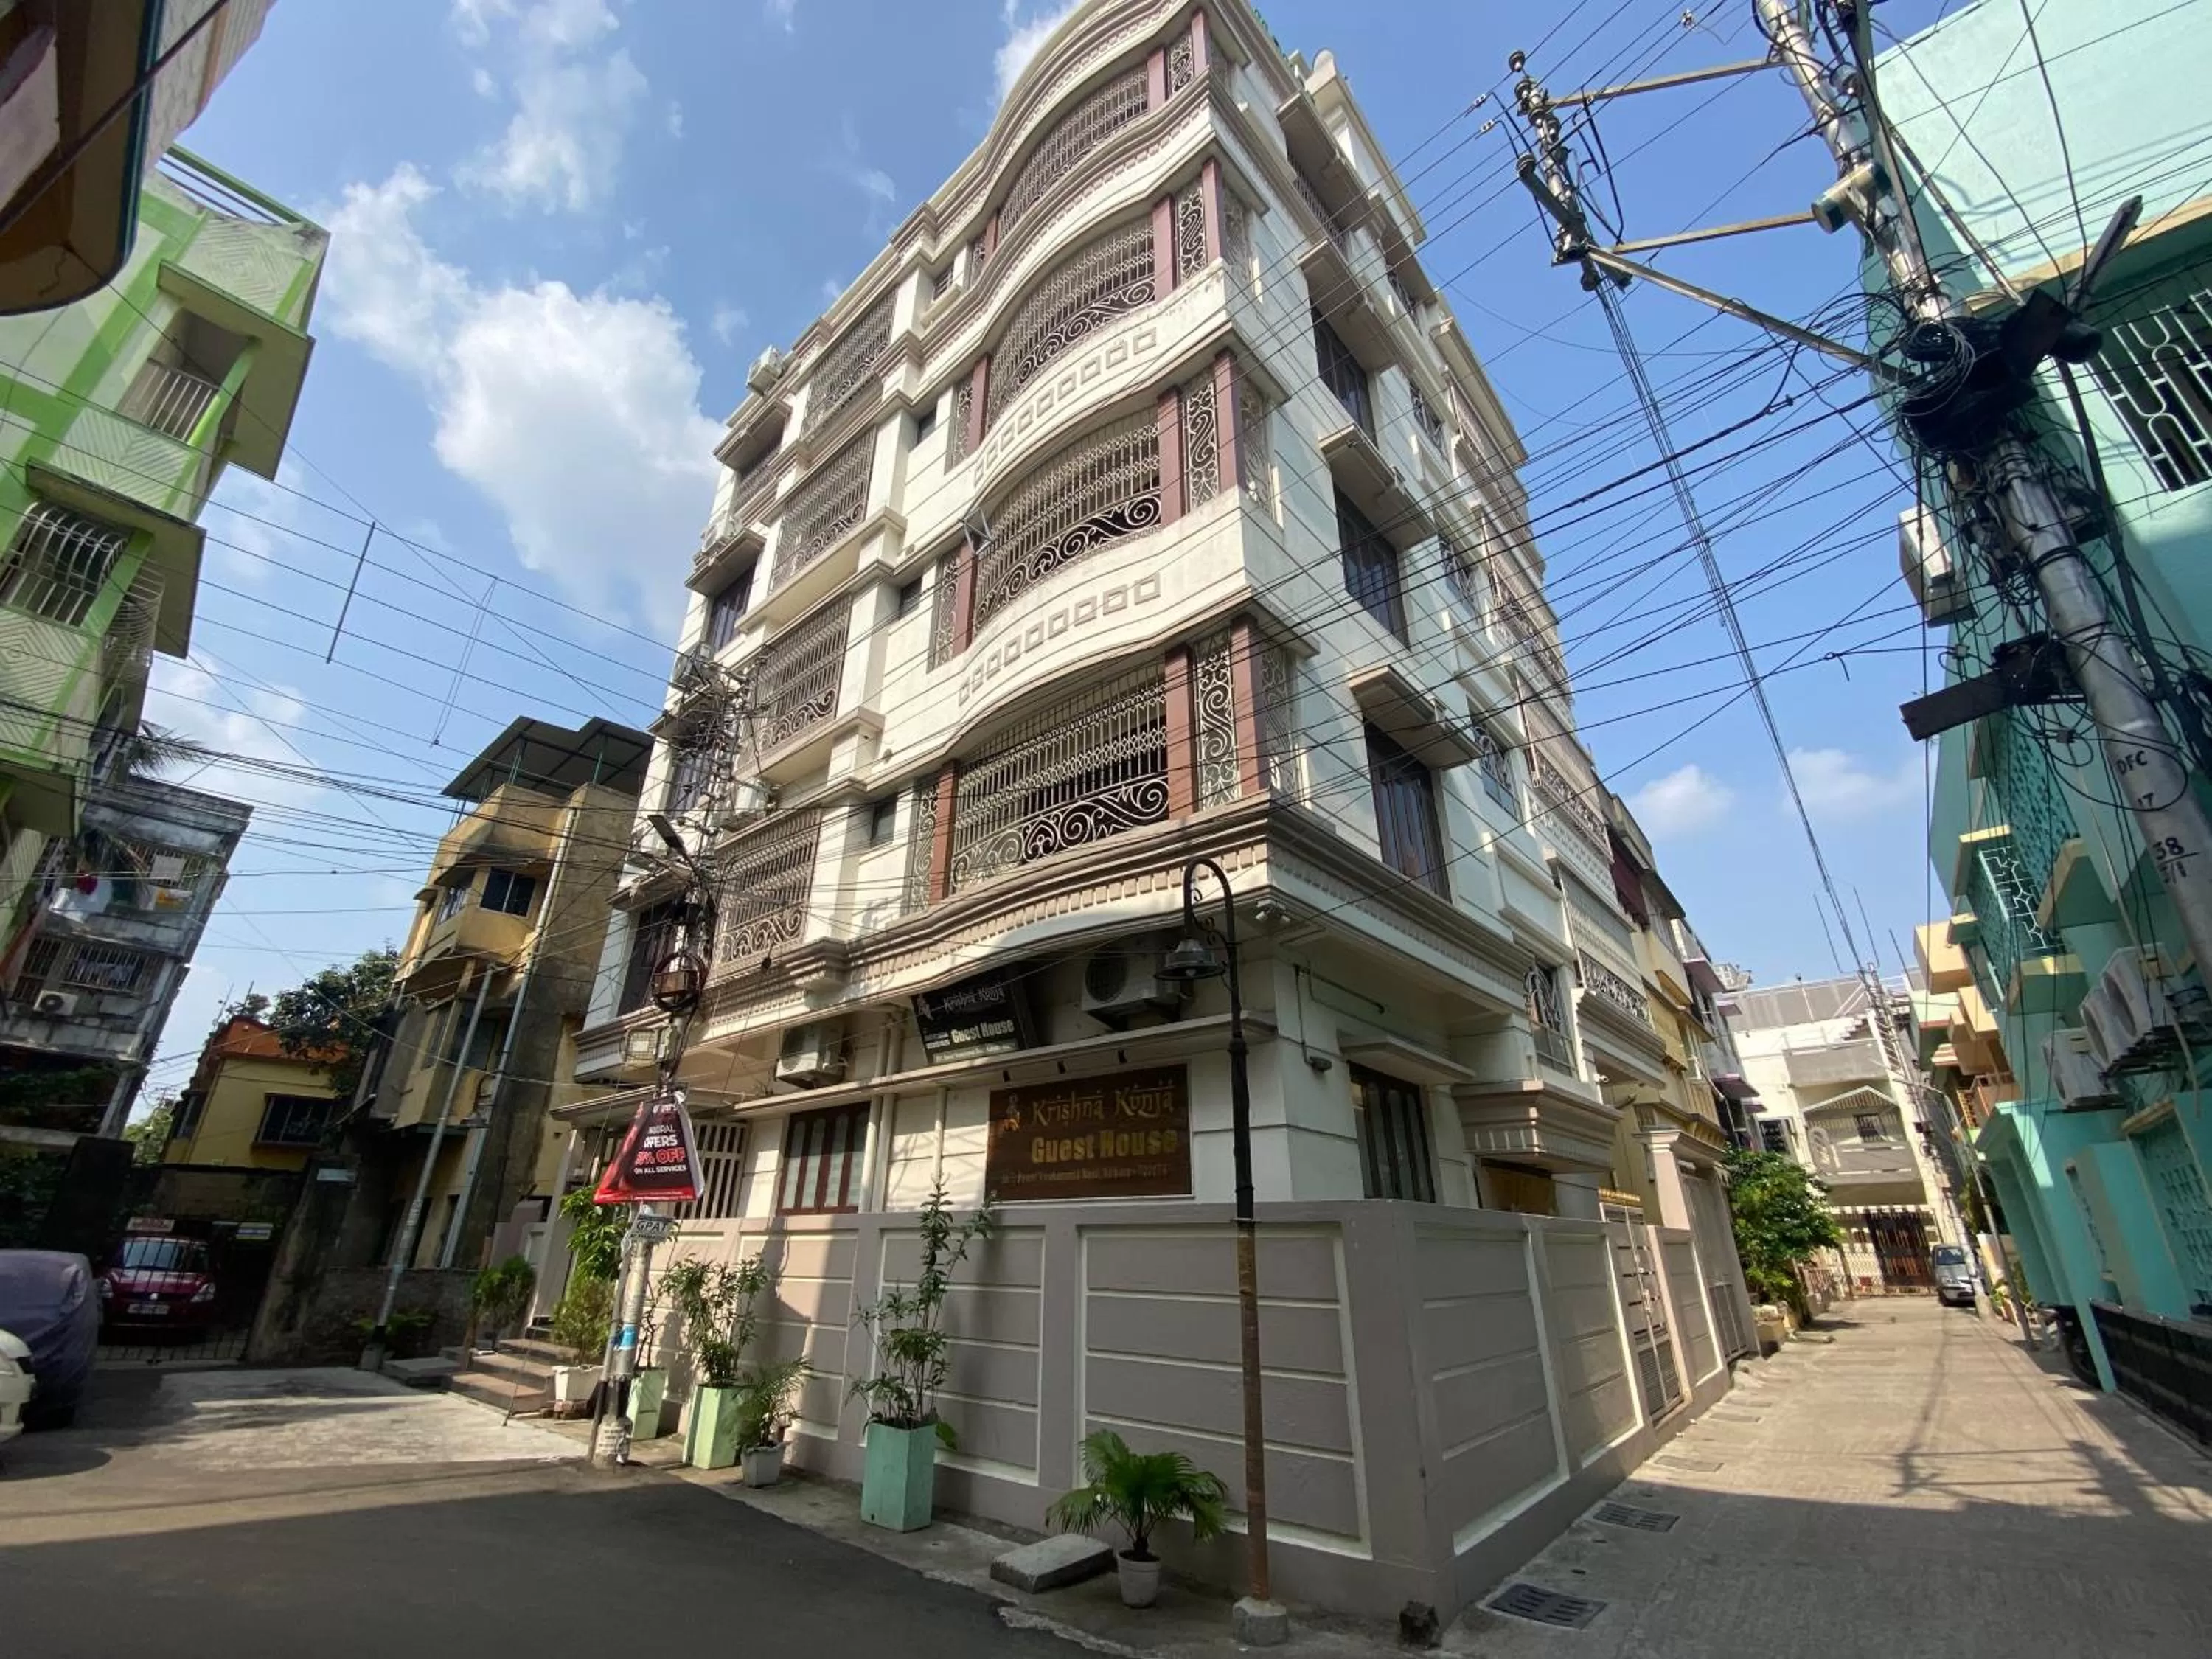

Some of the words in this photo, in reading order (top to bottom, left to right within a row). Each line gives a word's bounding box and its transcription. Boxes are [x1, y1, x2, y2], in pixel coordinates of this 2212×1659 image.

[2116, 751, 2148, 775] DFC
[951, 1025, 981, 1043] Guest
[981, 1020, 1015, 1038] House
[1032, 1090, 1105, 1127] Krishna
[656, 1147, 686, 1164] OFF
[1032, 1135, 1095, 1163] Guest
[1099, 1129, 1177, 1158] House
[656, 1164, 686, 1172] SERVICES
